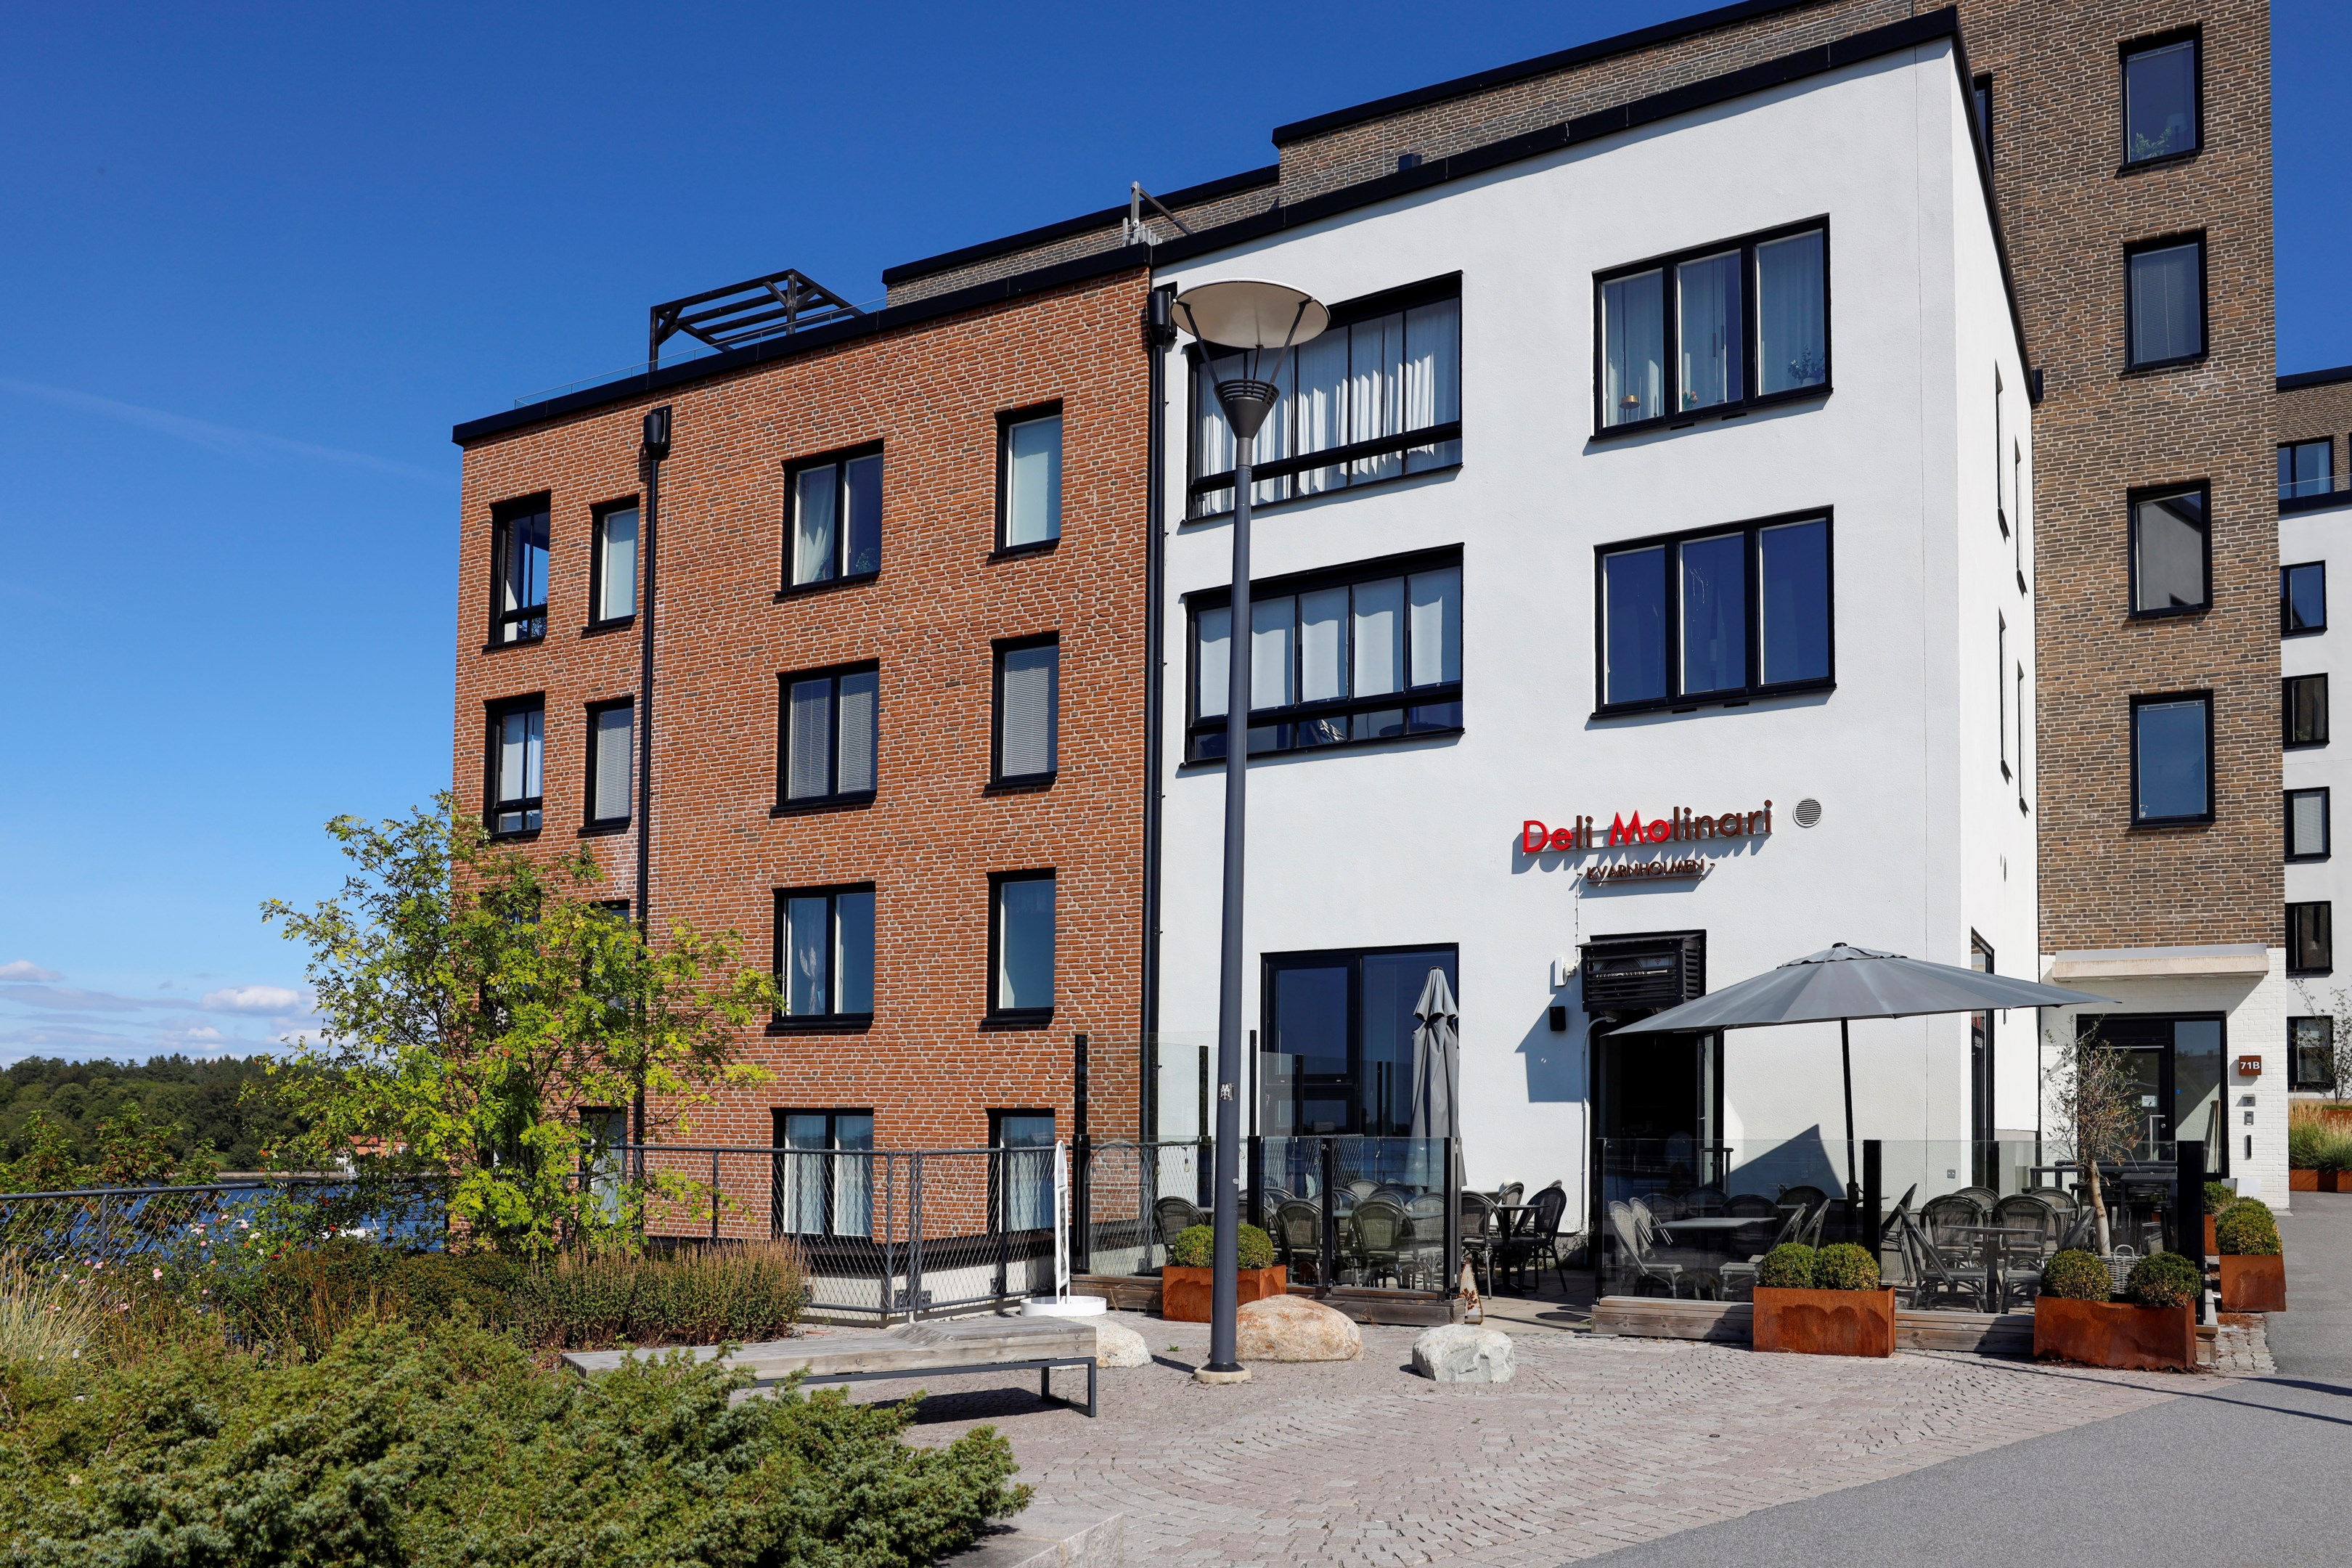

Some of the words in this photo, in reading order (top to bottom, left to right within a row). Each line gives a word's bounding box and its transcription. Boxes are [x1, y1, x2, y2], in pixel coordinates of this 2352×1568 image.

[1523, 815, 1593, 853] Deli
[1608, 799, 1773, 846] Molinari
[1587, 858, 1704, 880] KVARNHOLMEN
[2240, 1061, 2261, 1070] 71B
